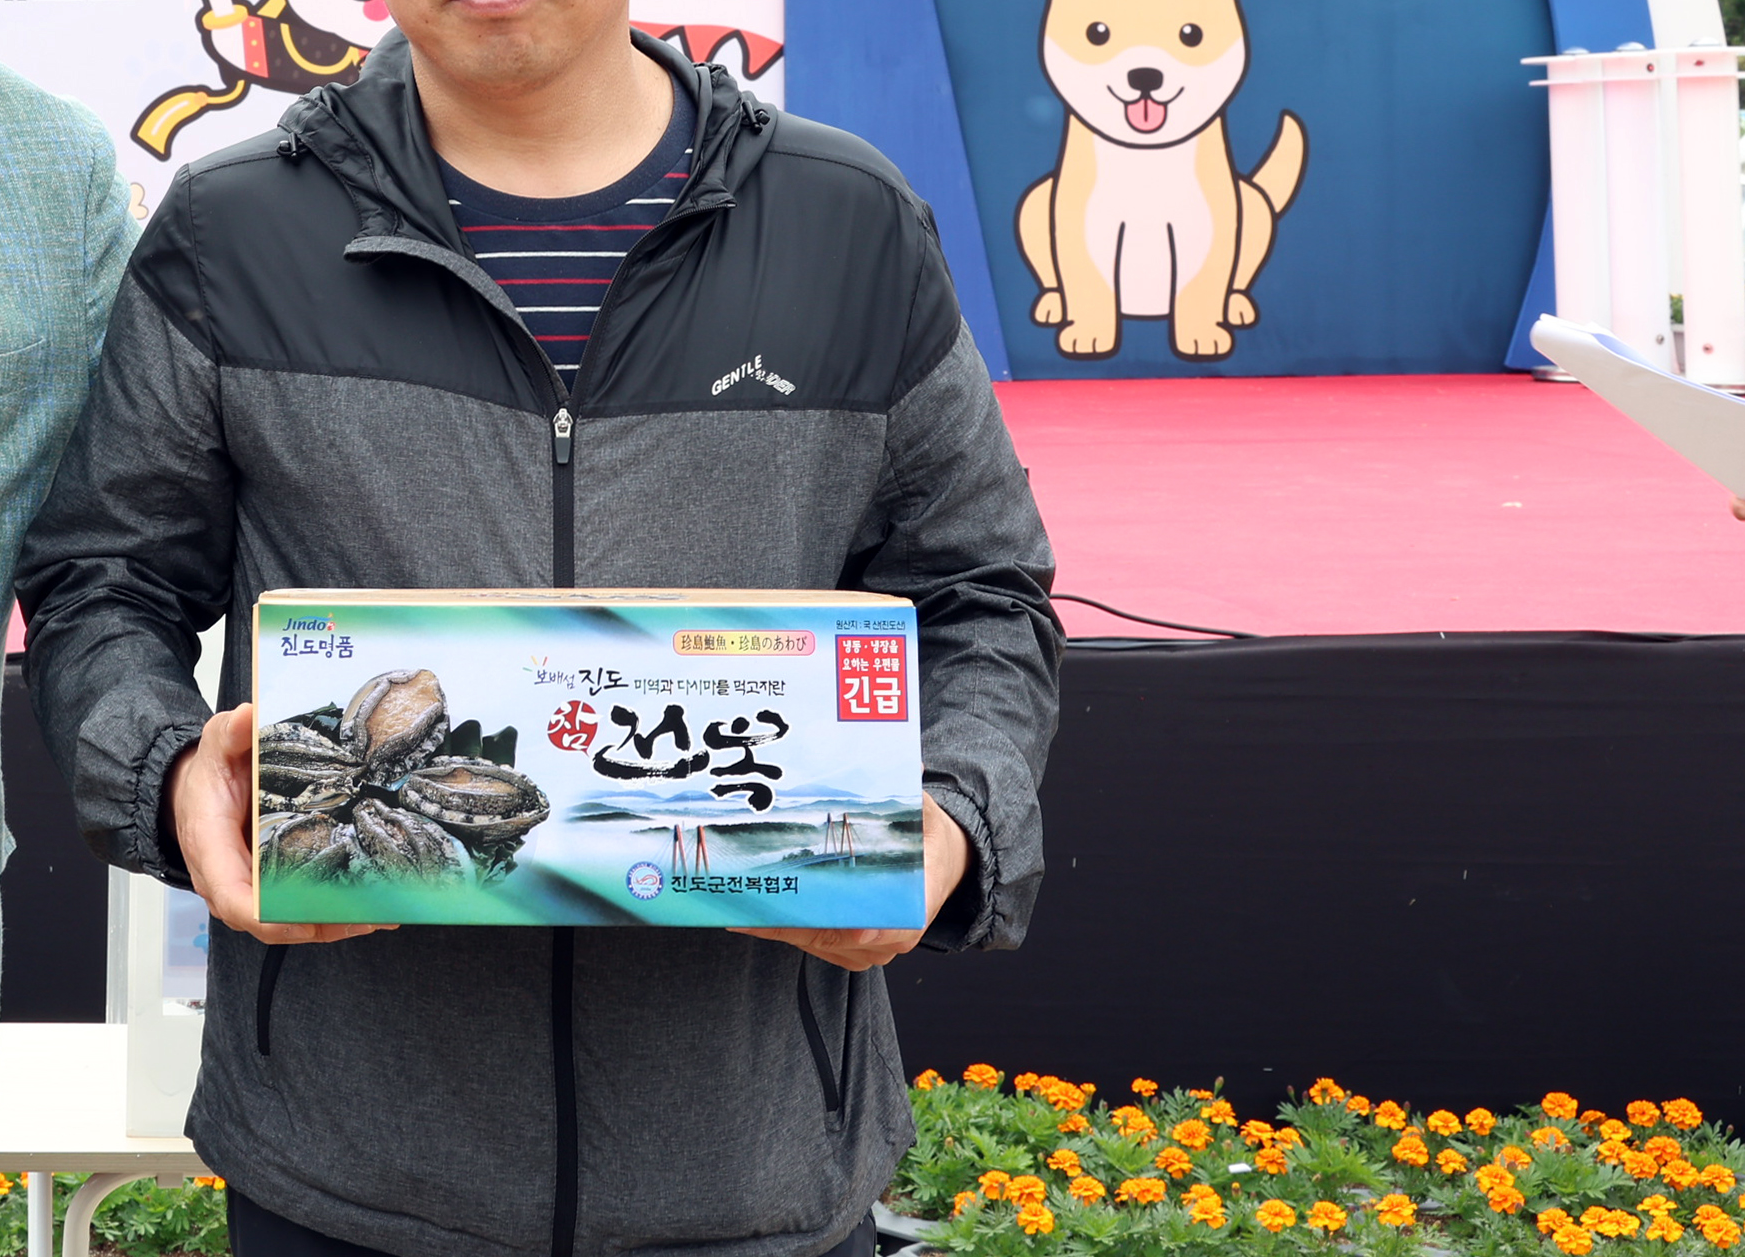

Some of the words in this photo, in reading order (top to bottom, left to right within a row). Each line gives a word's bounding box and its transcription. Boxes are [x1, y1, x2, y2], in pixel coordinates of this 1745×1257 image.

[711, 354, 762, 396] GENTLE
[282, 617, 326, 631] Jindo
[836, 619, 858, 630] 원산지
[280, 633, 354, 659] 진도명품
[842, 639, 862, 654] 냉동
[870, 639, 899, 654] 냉장을
[842, 657, 870, 672] 요하는
[872, 657, 901, 672] 우편물
[533, 669, 576, 690] 보배섬
[578, 666, 630, 697] 진도
[634, 678, 674, 695] 미역과
[677, 678, 730, 696] 다시마를
[733, 678, 787, 697] 먹고자란
[843, 675, 902, 714] 긴급
[548, 701, 603, 752] 참
[670, 874, 800, 895] 진도군전복협회
